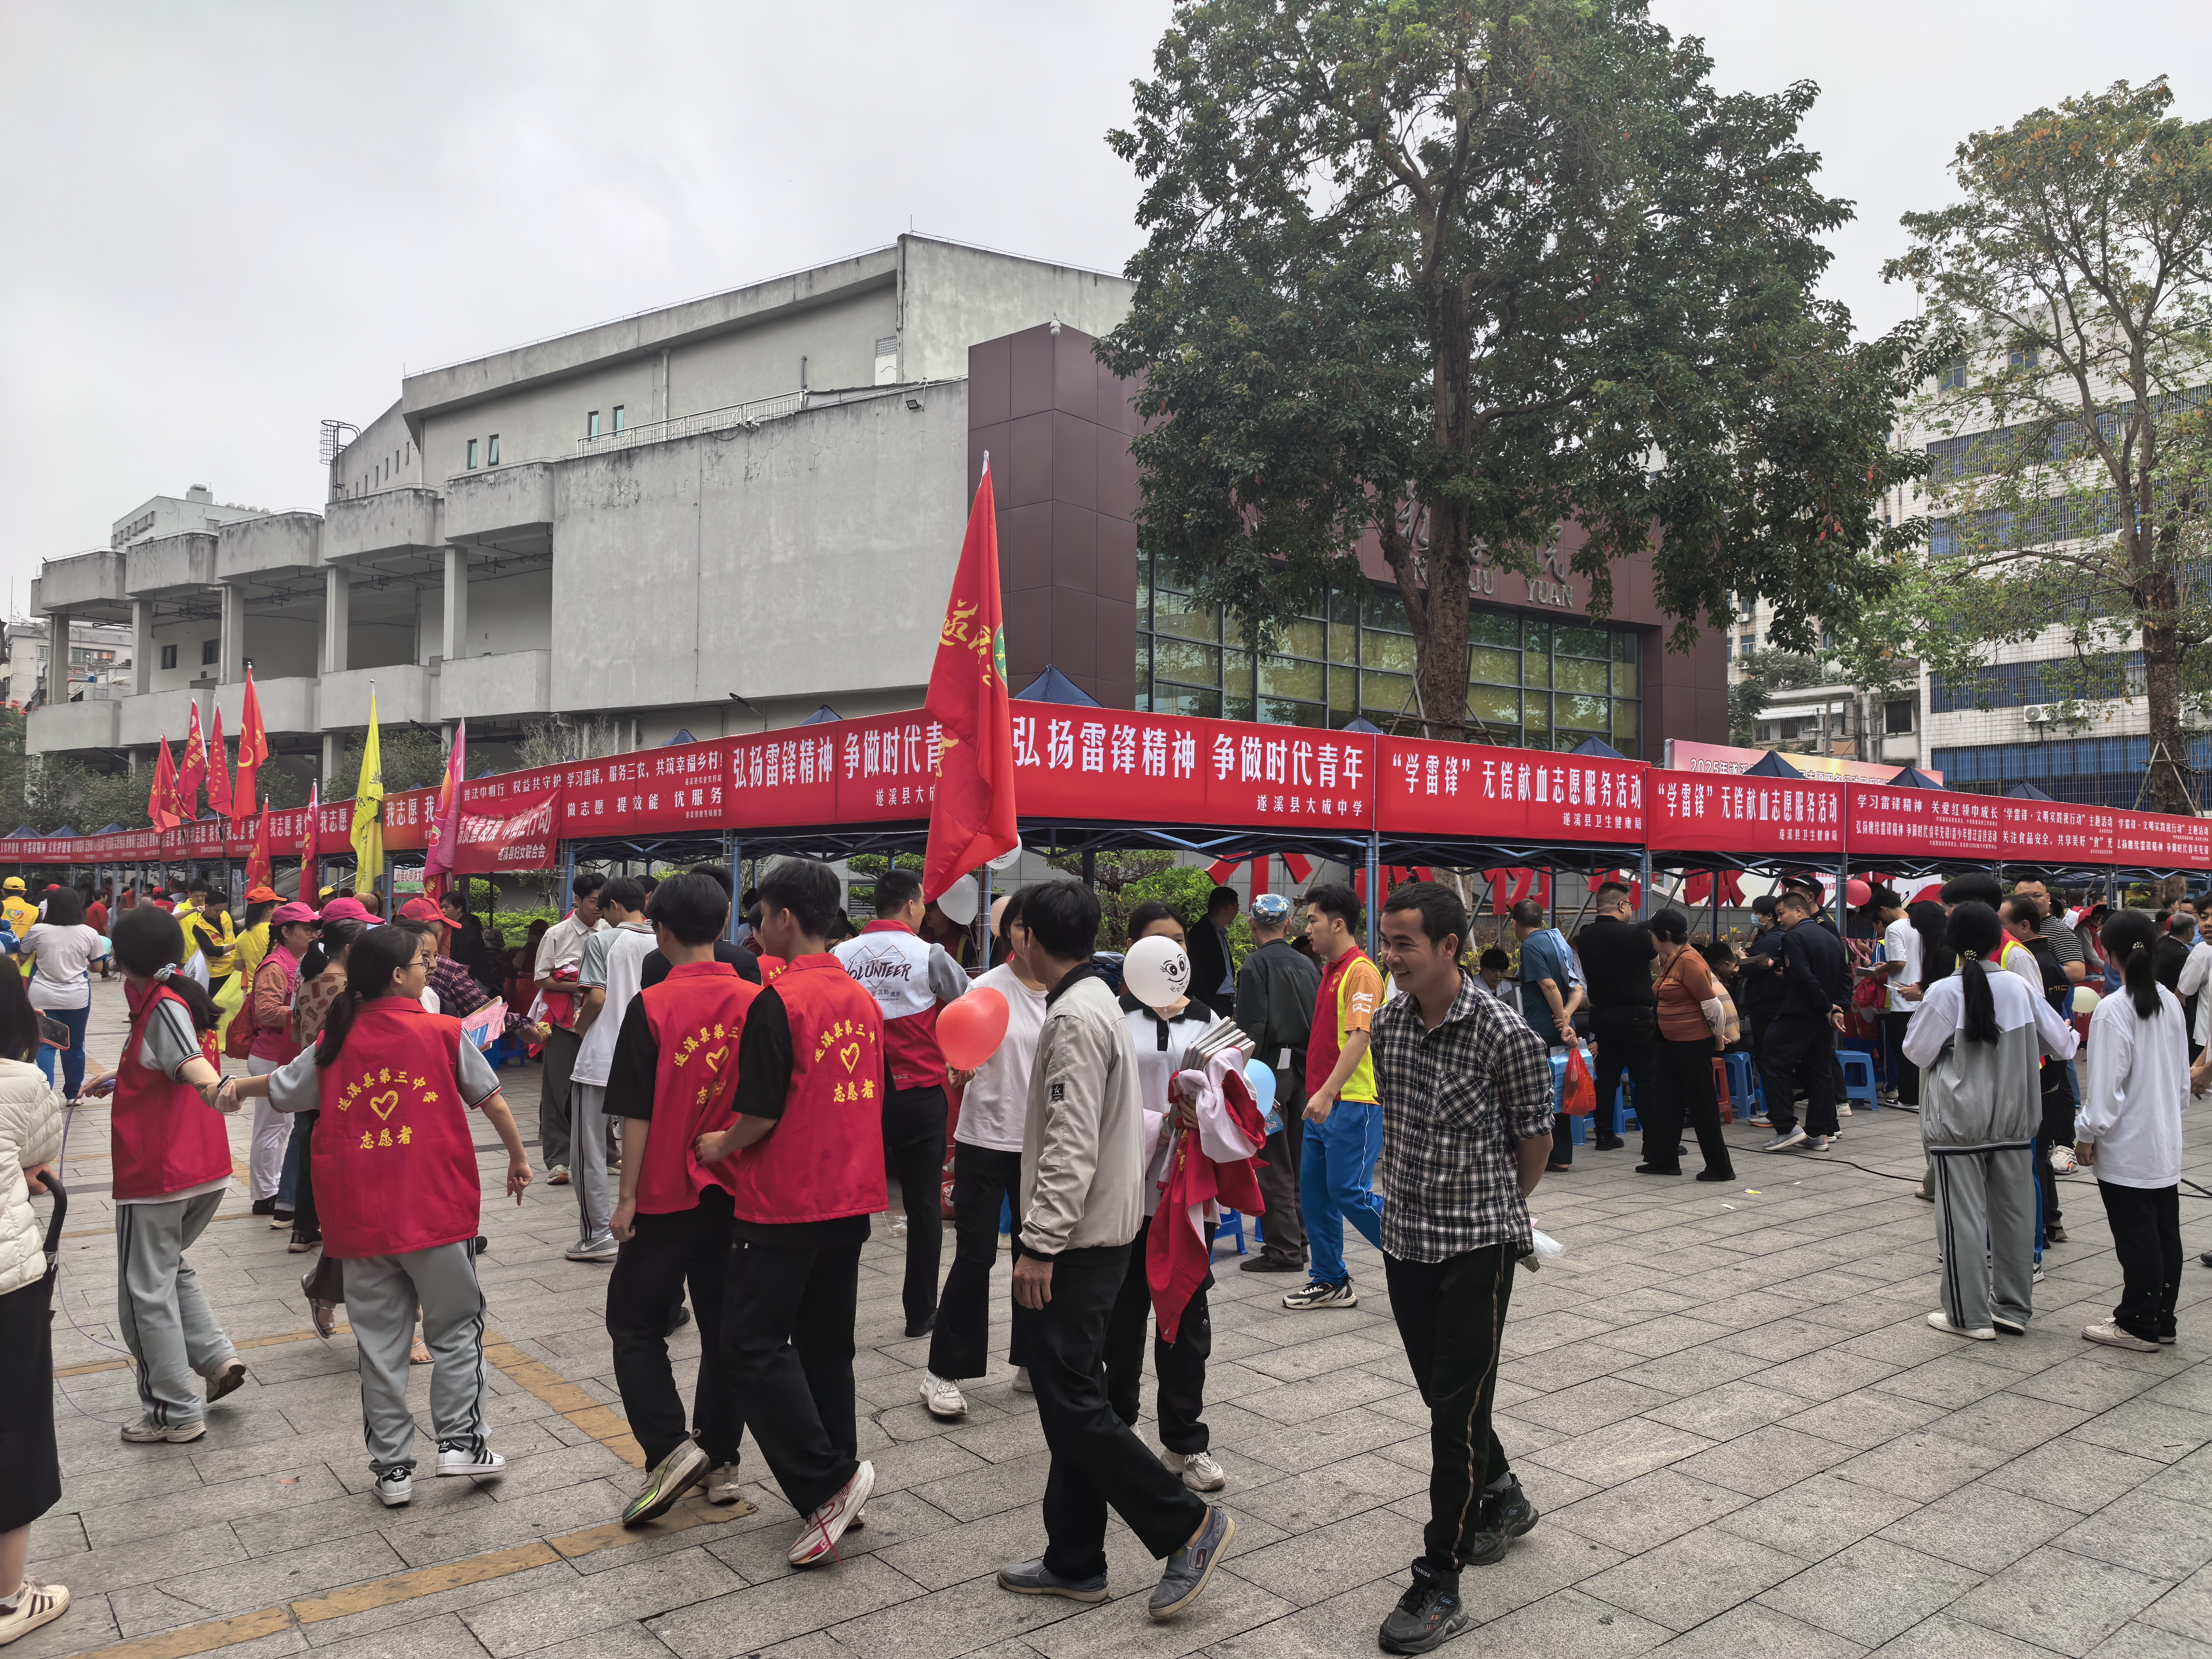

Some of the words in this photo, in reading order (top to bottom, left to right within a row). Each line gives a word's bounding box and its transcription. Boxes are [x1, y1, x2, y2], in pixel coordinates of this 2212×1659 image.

[1525, 578, 1573, 609] YUAN
[733, 736, 833, 789] 弘扬雷锋精神
[1013, 716, 1196, 779] 弘扬雷锋精神
[1212, 733, 1363, 790] 争做时代青年
[1690, 758, 1755, 774] 2025年遂溪
[464, 783, 504, 801] 普法巾帼行
[514, 774, 561, 794] 权益共守护
[1393, 753, 1470, 796] “学雷锋”
[1482, 760, 1641, 809] 无偿献血志愿服务活动
[386, 798, 417, 827] 我志愿
[568, 799, 604, 818] 做志愿
[617, 793, 658, 813] 提效能
[675, 787, 722, 808] 优服务
[1257, 794, 1363, 817] 遂溪县大成中学
[1658, 783, 1712, 818] “学雷锋”
[1721, 786, 1837, 824] 无偿献血志愿服务活动
[1857, 794, 1923, 813] 学习雷锋精神
[1931, 800, 1998, 819] 关爱红领巾成长
[320, 808, 347, 833] 我志愿
[1563, 812, 1641, 830] 遂溪县卫生健康局
[2089, 815, 2113, 828] 主题活动
[1779, 828, 1837, 841] 遂溪县卫生健康局
[497, 843, 546, 861] 遂溪县妇女联合会
[338, 1068, 439, 1111] 遂溪县第三中学
[833, 1079, 875, 1102] 志愿者
[360, 1125, 413, 1149] 志愿者
